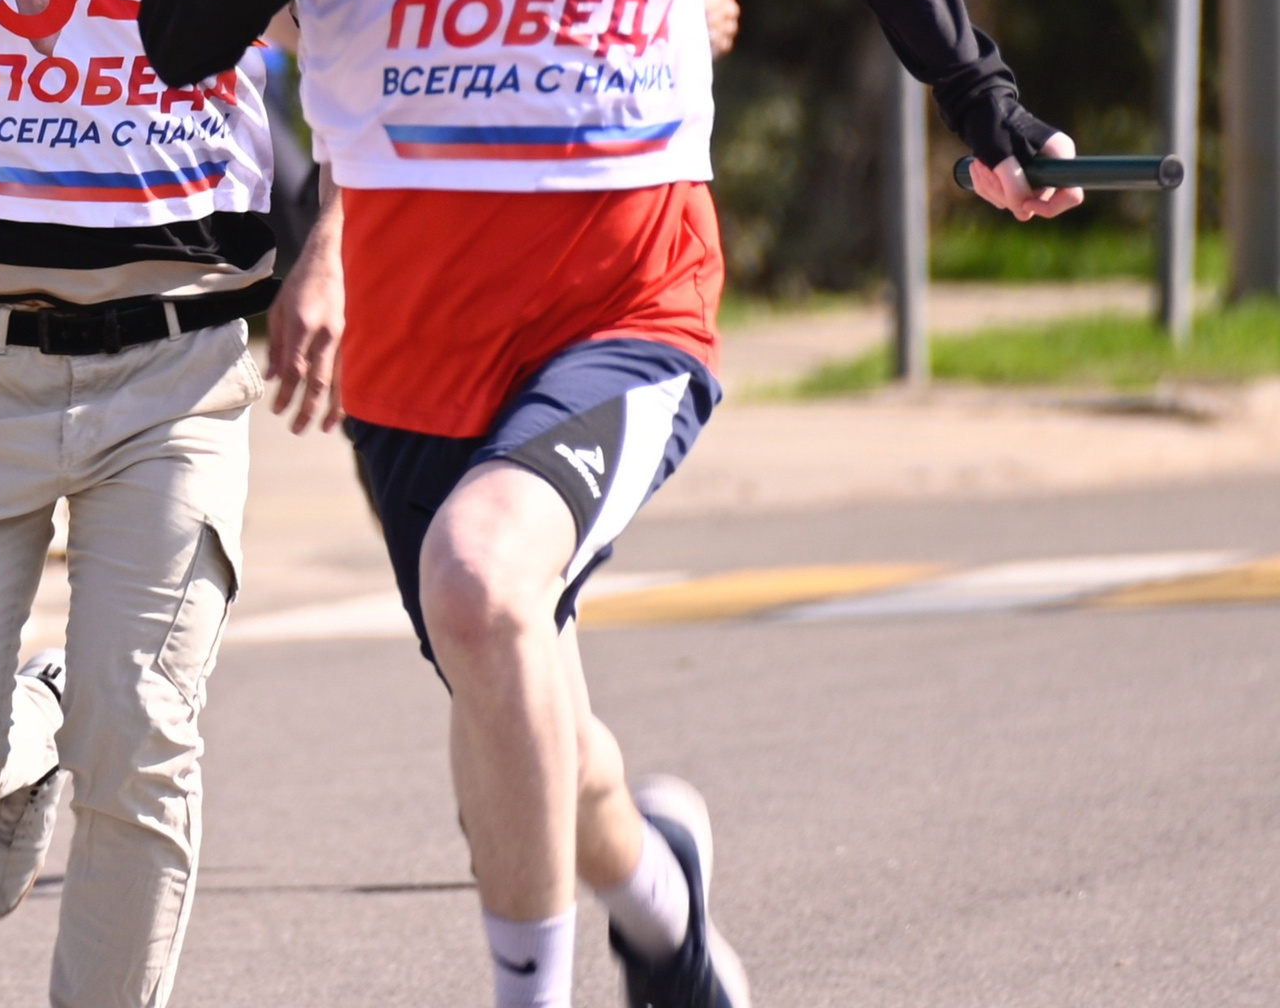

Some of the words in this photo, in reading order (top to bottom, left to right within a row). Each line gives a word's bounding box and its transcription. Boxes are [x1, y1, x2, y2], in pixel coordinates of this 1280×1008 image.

[382, 64, 521, 99] ВСЕГДА
[534, 64, 566, 93] С
[111, 120, 137, 147] С
